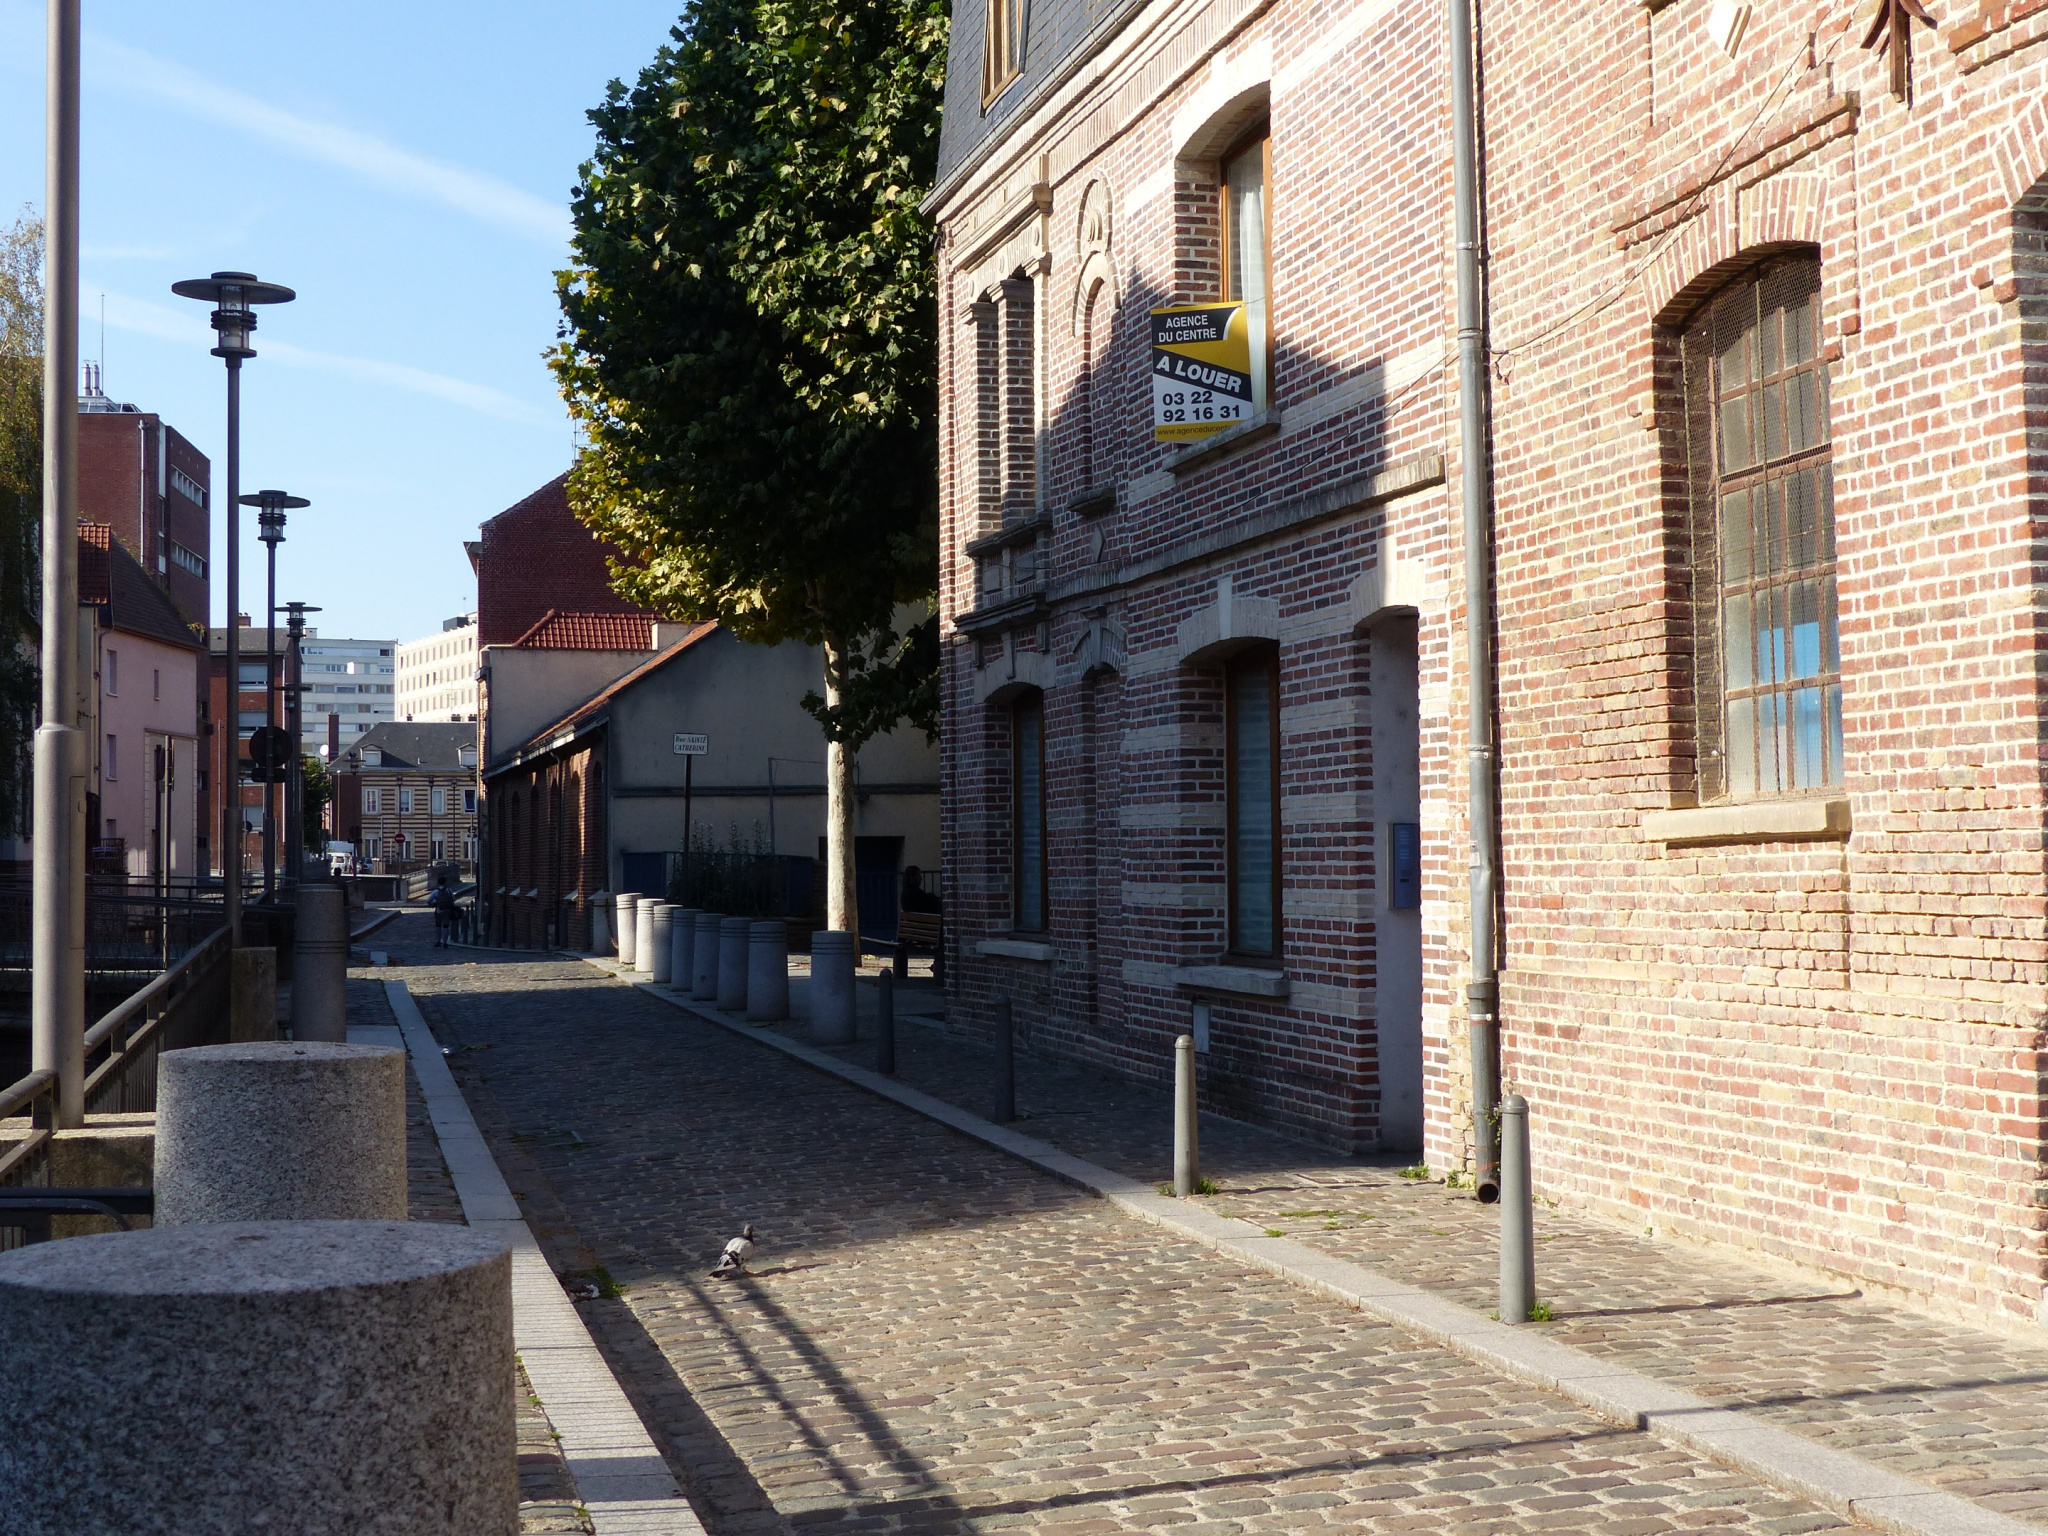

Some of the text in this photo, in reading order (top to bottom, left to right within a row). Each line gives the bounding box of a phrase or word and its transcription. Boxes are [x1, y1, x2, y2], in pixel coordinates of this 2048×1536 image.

[1166, 315, 1208, 328] AGENCE
[1158, 328, 1217, 343] DU CENTRE
[1156, 355, 1241, 392] A LOUER
[1162, 390, 1213, 406] 03 22
[1163, 405, 1240, 422] 92 16 31
[675, 735, 706, 744] Rue SAINTE
[675, 744, 705, 752] CATHERINE
